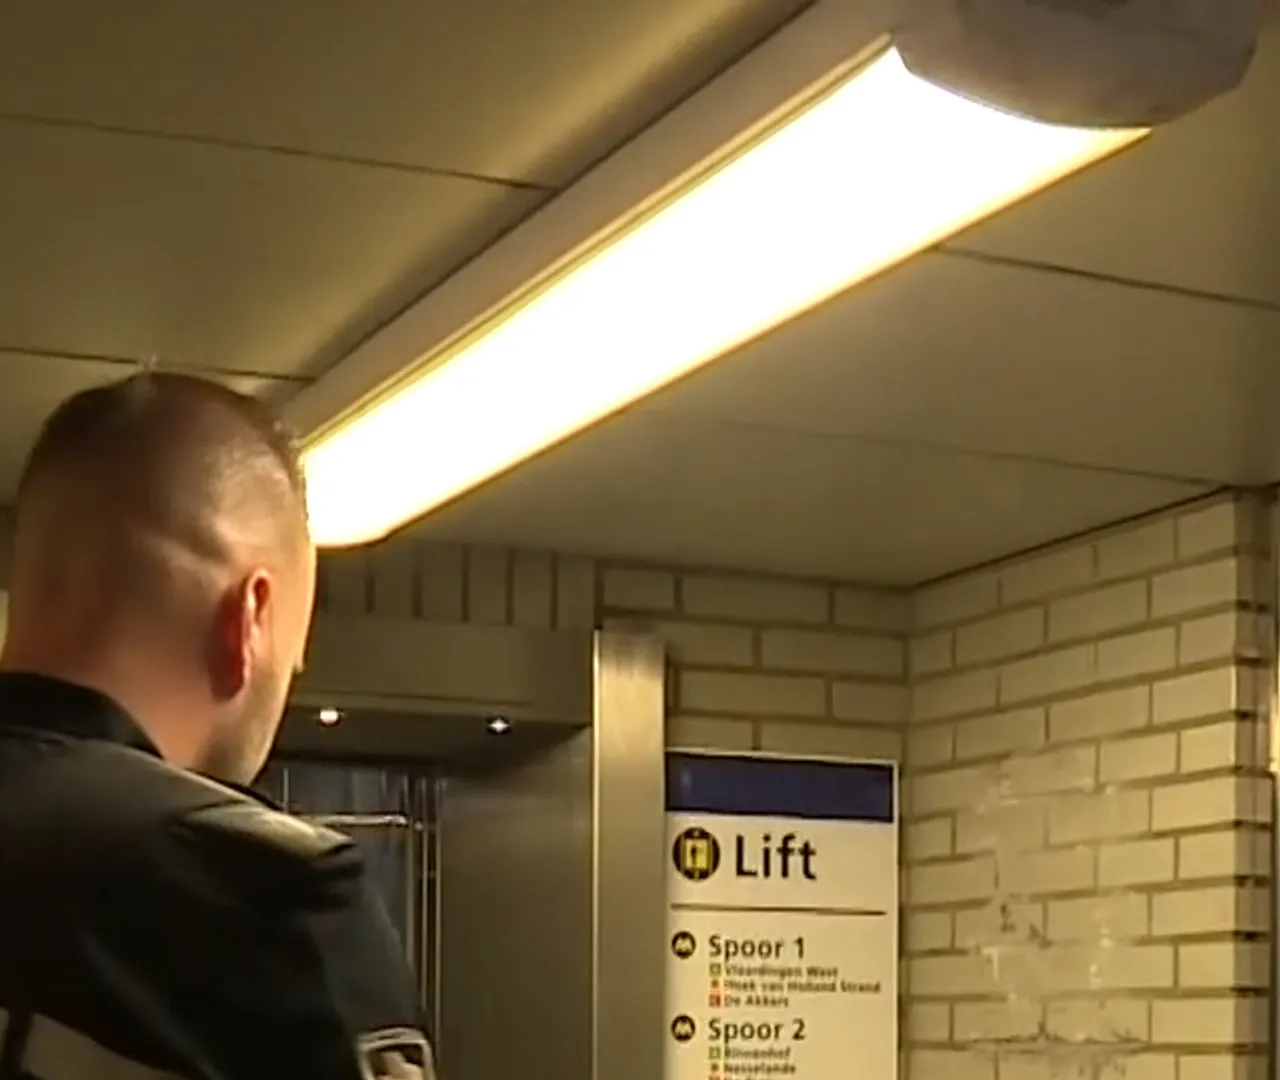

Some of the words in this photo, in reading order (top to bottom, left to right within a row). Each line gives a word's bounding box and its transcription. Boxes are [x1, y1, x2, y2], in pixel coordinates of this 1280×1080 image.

[735, 832, 817, 879] Lift
[708, 935, 784, 960] Spoor
[793, 936, 805, 959] 1
[725, 964, 802, 977] Vlaardingen
[807, 966, 838, 977] West
[724, 980, 756, 991] Hoek
[761, 982, 784, 992] van
[788, 981, 836, 993] Holland
[840, 981, 881, 994] Strand
[724, 995, 741, 1006] De
[745, 995, 789, 1007] Akkers
[708, 1018, 784, 1043] Spoor
[792, 1018, 805, 1040] 2
[724, 1062, 796, 1074] Nesselande
